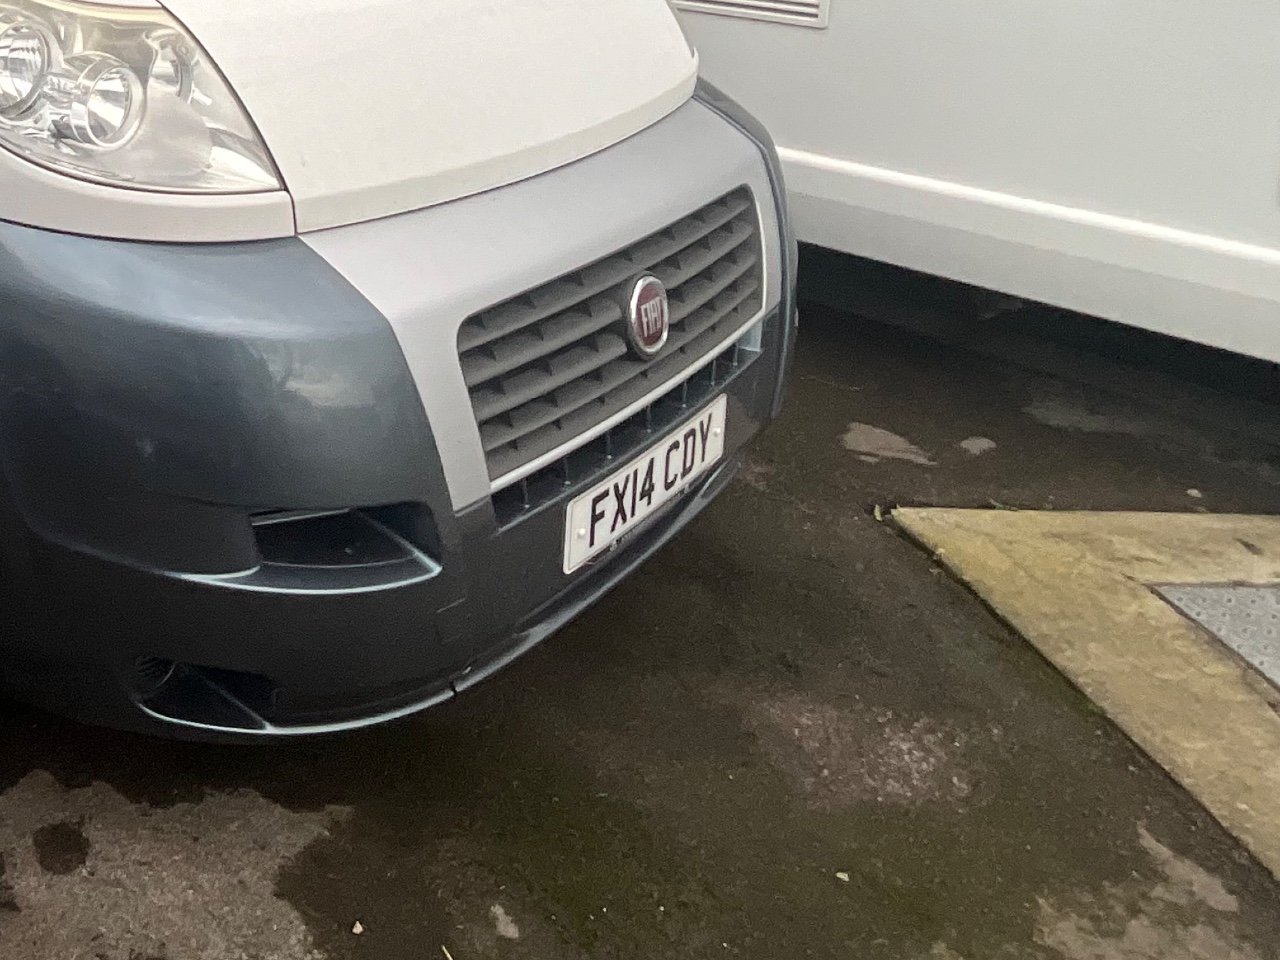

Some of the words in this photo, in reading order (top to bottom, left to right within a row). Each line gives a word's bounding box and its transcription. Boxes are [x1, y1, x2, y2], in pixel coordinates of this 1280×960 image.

[640, 295, 664, 338] FIAT
[588, 457, 655, 548] FX14
[664, 412, 713, 492] CDY
